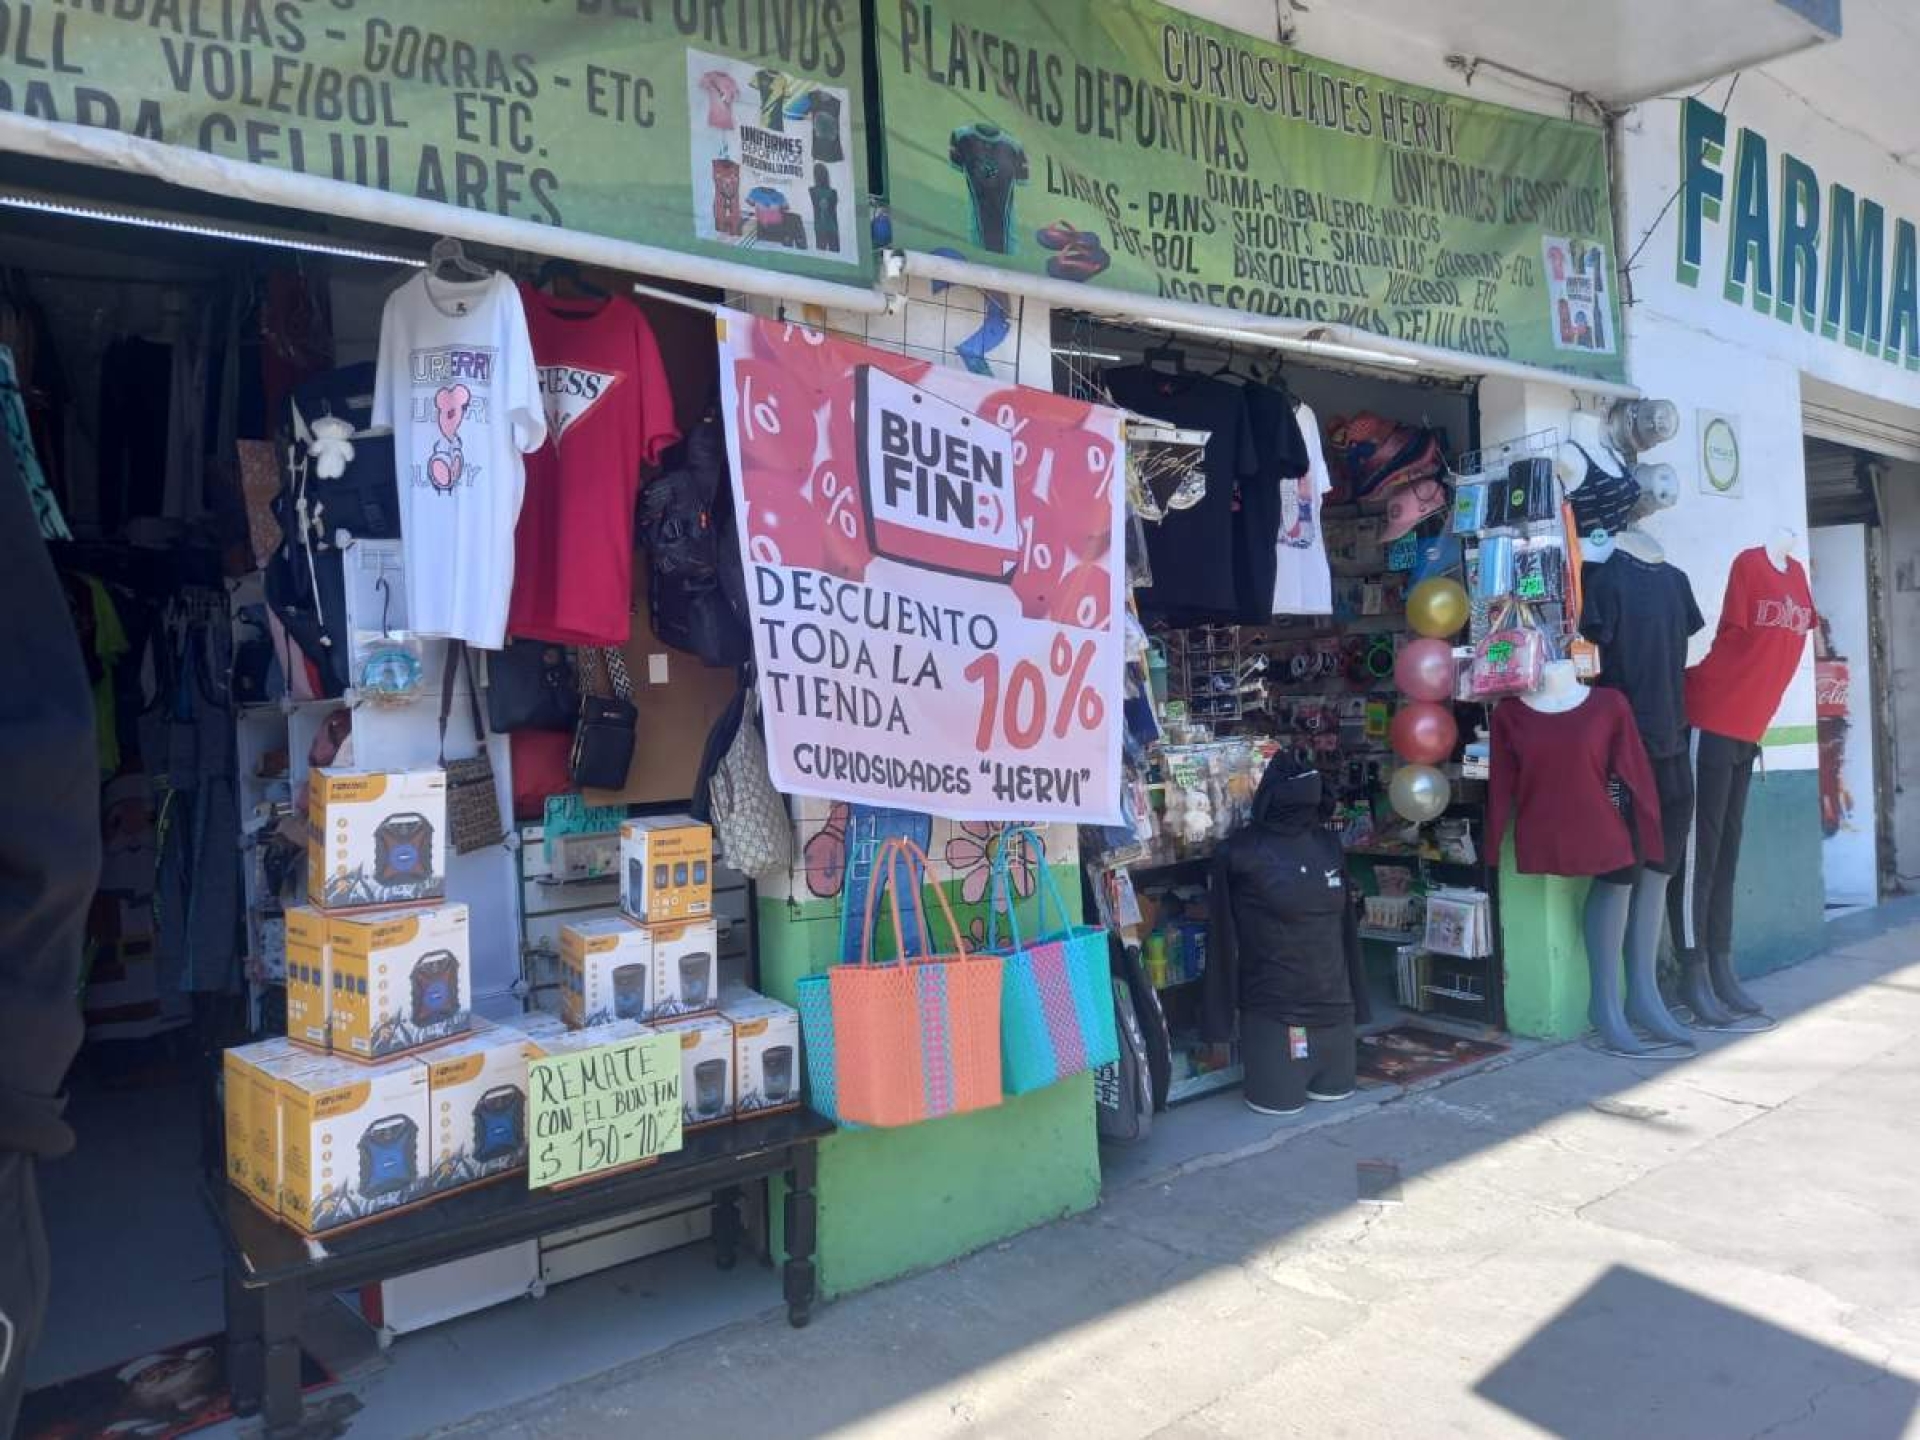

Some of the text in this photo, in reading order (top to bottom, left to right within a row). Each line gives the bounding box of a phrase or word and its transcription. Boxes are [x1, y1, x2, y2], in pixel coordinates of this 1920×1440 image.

[160, 36, 409, 128] VOLEIBOL
[455, 92, 548, 157] ETC.
[364, 18, 539, 99] GORRAS
[586, 64, 655, 128] ETC
[1163, 23, 1373, 138] CURIOSIDADES
[1074, 63, 1249, 172] DEPORTIVAS
[1388, 149, 1499, 225] UNIFORMES
[1148, 191, 1216, 235] PANS
[1231, 210, 1313, 256] SHORTS
[1331, 231, 1427, 282] SANDALIAS
[1509, 254, 1535, 288] ETC
[1233, 243, 1369, 299] BASQUETBOLL
[1675, 97, 1920, 373] FARMA
[880, 408, 1004, 490] BUEN
[755, 564, 999, 651] DESCUENTO
[759, 617, 943, 691] TODA LA
[964, 632, 1104, 753] 10%
[767, 669, 911, 736] TIENDA
[793, 742, 973, 796] CURIOSIDADES
[530, 1044, 657, 1105] REMATE
[537, 1096, 572, 1138] CON
[583, 1100, 605, 1124] EL
